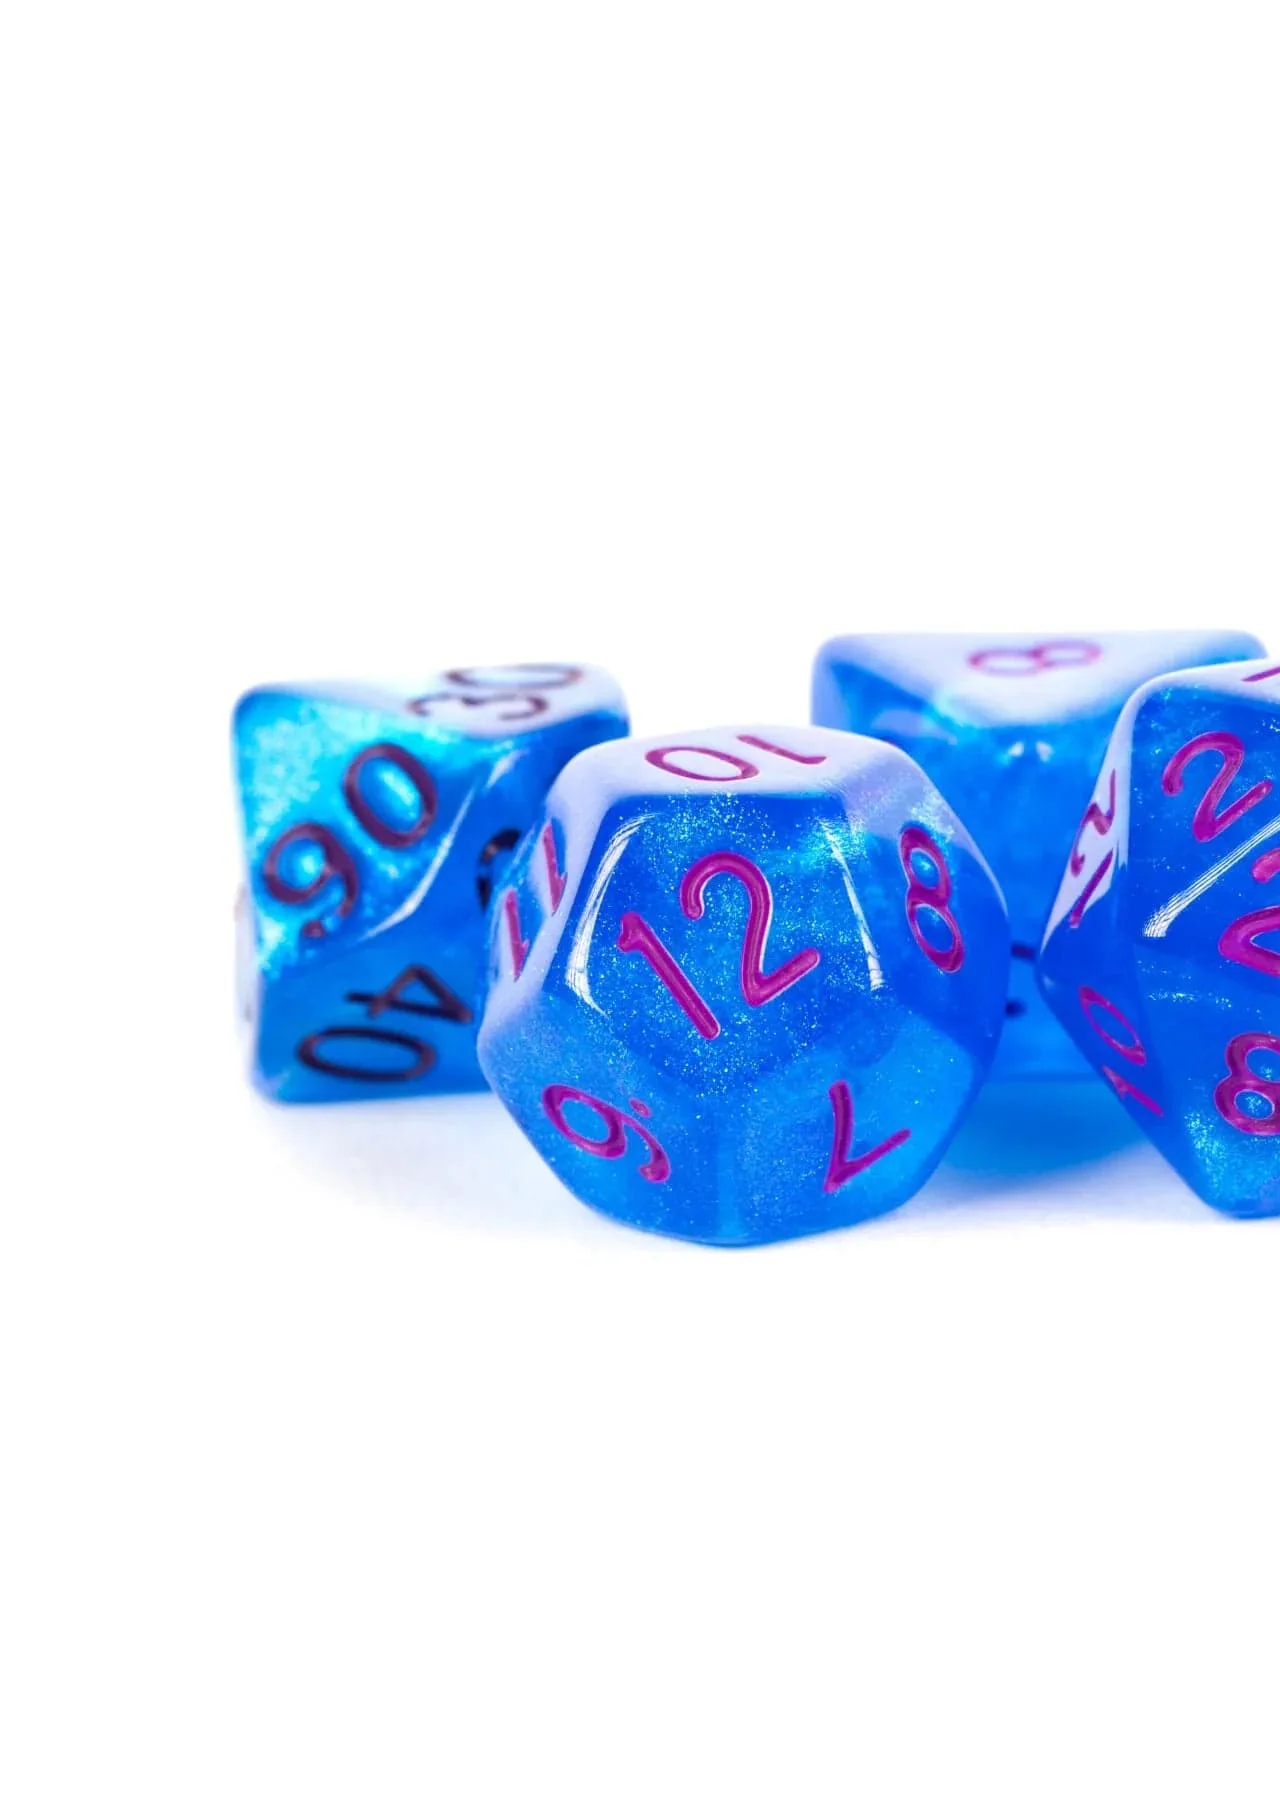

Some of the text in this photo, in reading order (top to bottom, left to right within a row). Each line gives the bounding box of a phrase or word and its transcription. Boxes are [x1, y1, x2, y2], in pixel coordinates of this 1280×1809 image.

[407, 662, 583, 721] 30
[966, 640, 1102, 677] 8
[643, 733, 828, 783] 10
[1161, 731, 1272, 843] 2
[503, 822, 569, 982] 11
[899, 826, 965, 973] 8
[1069, 768, 1118, 928] 12
[616, 850, 821, 1041] 12
[296, 965, 473, 1084] 40
[1078, 986, 1163, 1117] 10
[823, 1080, 911, 1193] 7
